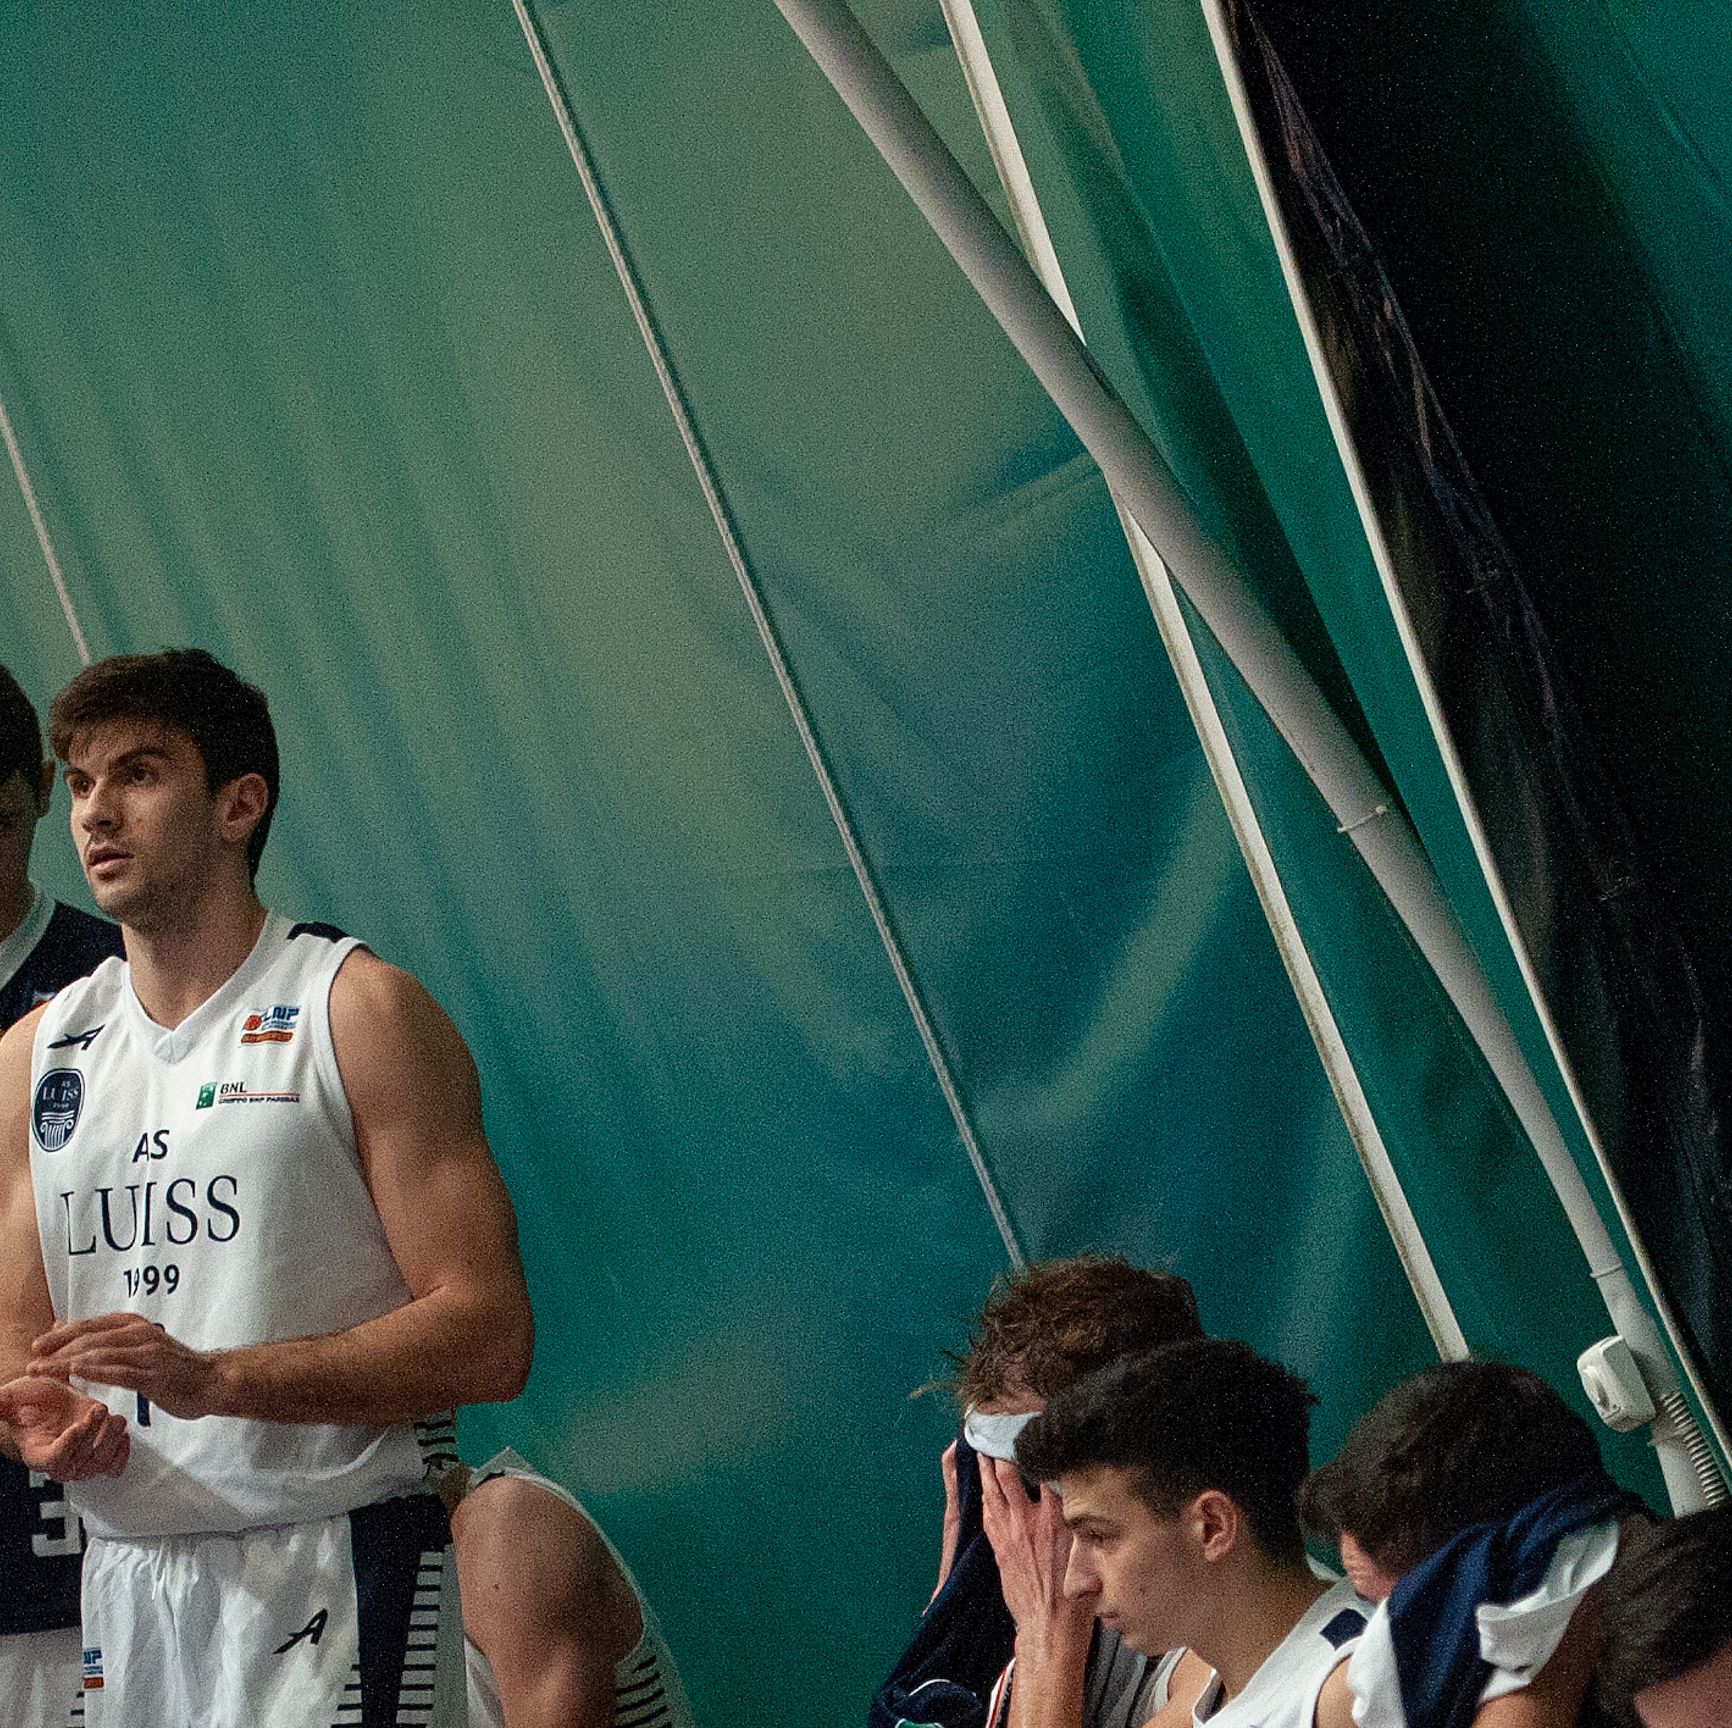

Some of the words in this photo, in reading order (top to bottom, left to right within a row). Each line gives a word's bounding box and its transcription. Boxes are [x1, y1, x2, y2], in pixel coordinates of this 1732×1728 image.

[220, 1082, 248, 1094] BNL
[132, 1129, 170, 1163] AS
[60, 1174, 242, 1256] LUISS
[123, 1264, 181, 1299] 1999
